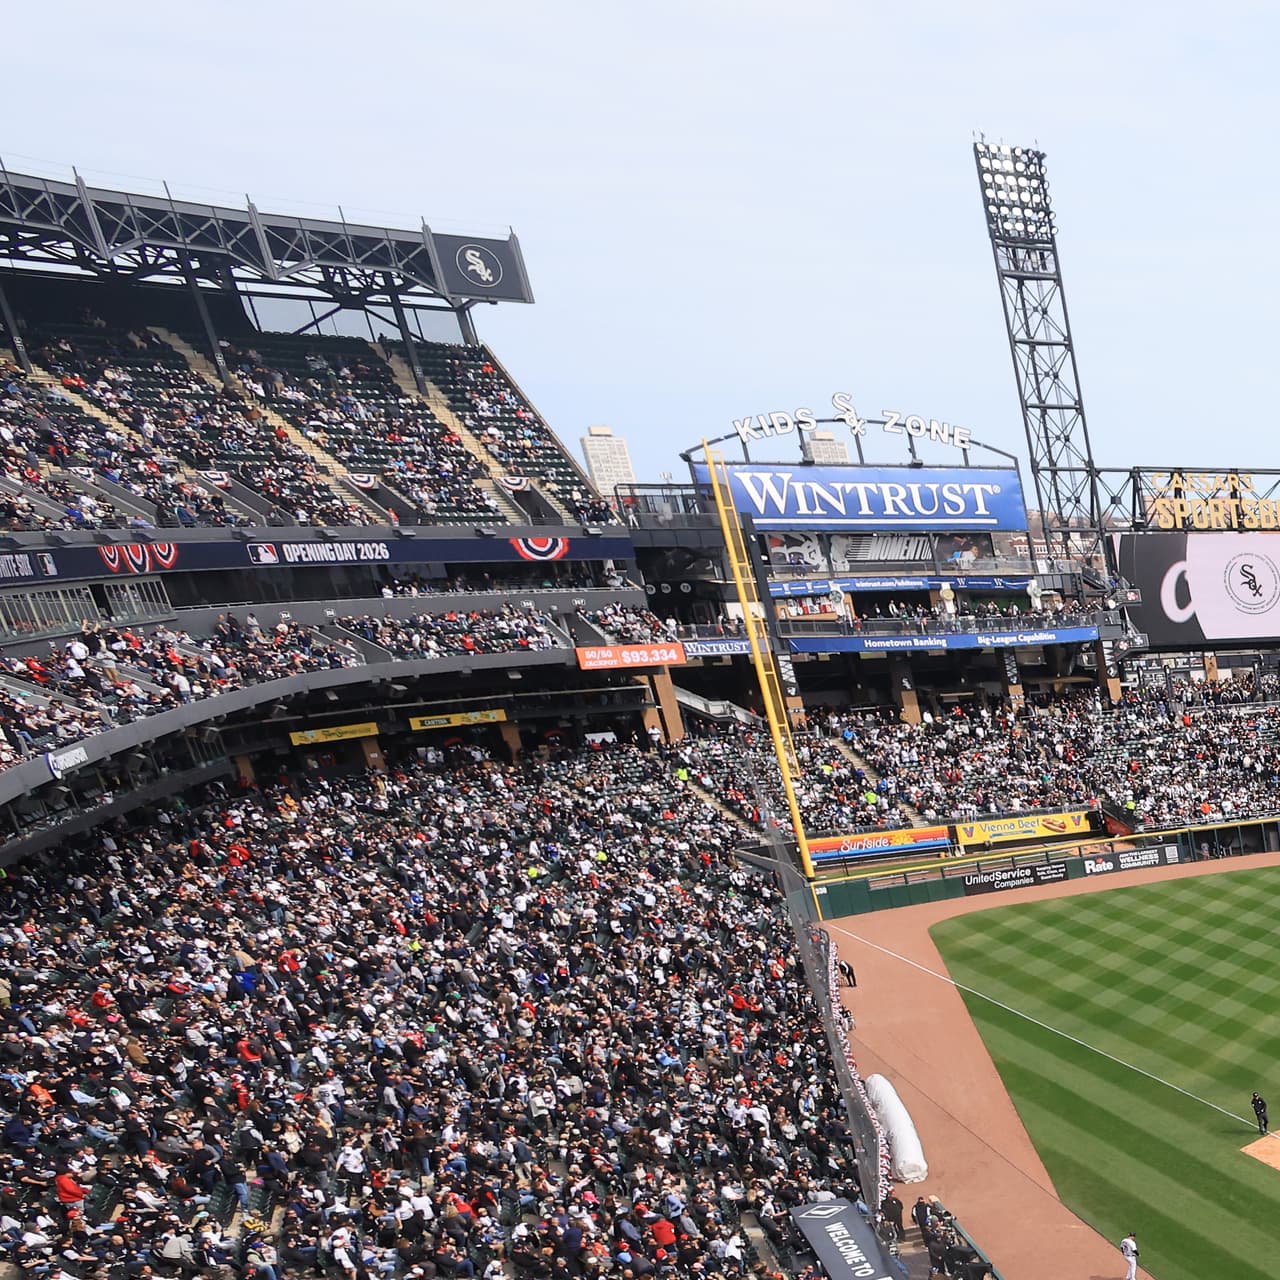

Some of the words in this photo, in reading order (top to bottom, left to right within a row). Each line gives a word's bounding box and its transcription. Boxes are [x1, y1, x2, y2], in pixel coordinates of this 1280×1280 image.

[733, 407, 817, 443] KIDS
[881, 410, 972, 449] ZONE
[1151, 473, 1256, 492] CAESARS
[283, 546, 337, 563] OPENING
[336, 545, 357, 562] DAY
[357, 543, 390, 561] 2026
[685, 640, 748, 653] WINTRUST
[864, 638, 912, 648] Hometown
[913, 638, 948, 649] Banking
[978, 635, 1016, 646] Big-League
[1018, 632, 1056, 644] Capabilities
[584, 650, 612, 659] 50/50
[621, 648, 678, 664] $93,334
[980, 820, 1015, 832] Vienna
[1016, 818, 1042, 830] Beef
[840, 836, 890, 853] Surfside
[1084, 860, 1114, 874] Rate
[1120, 854, 1159, 865] WELLNESS
[1120, 859, 1160, 870] COMMUNITY
[994, 877, 1034, 890] Companies
[824, 1222, 859, 1267] WELCOME
[854, 1261, 874, 1278] TO
